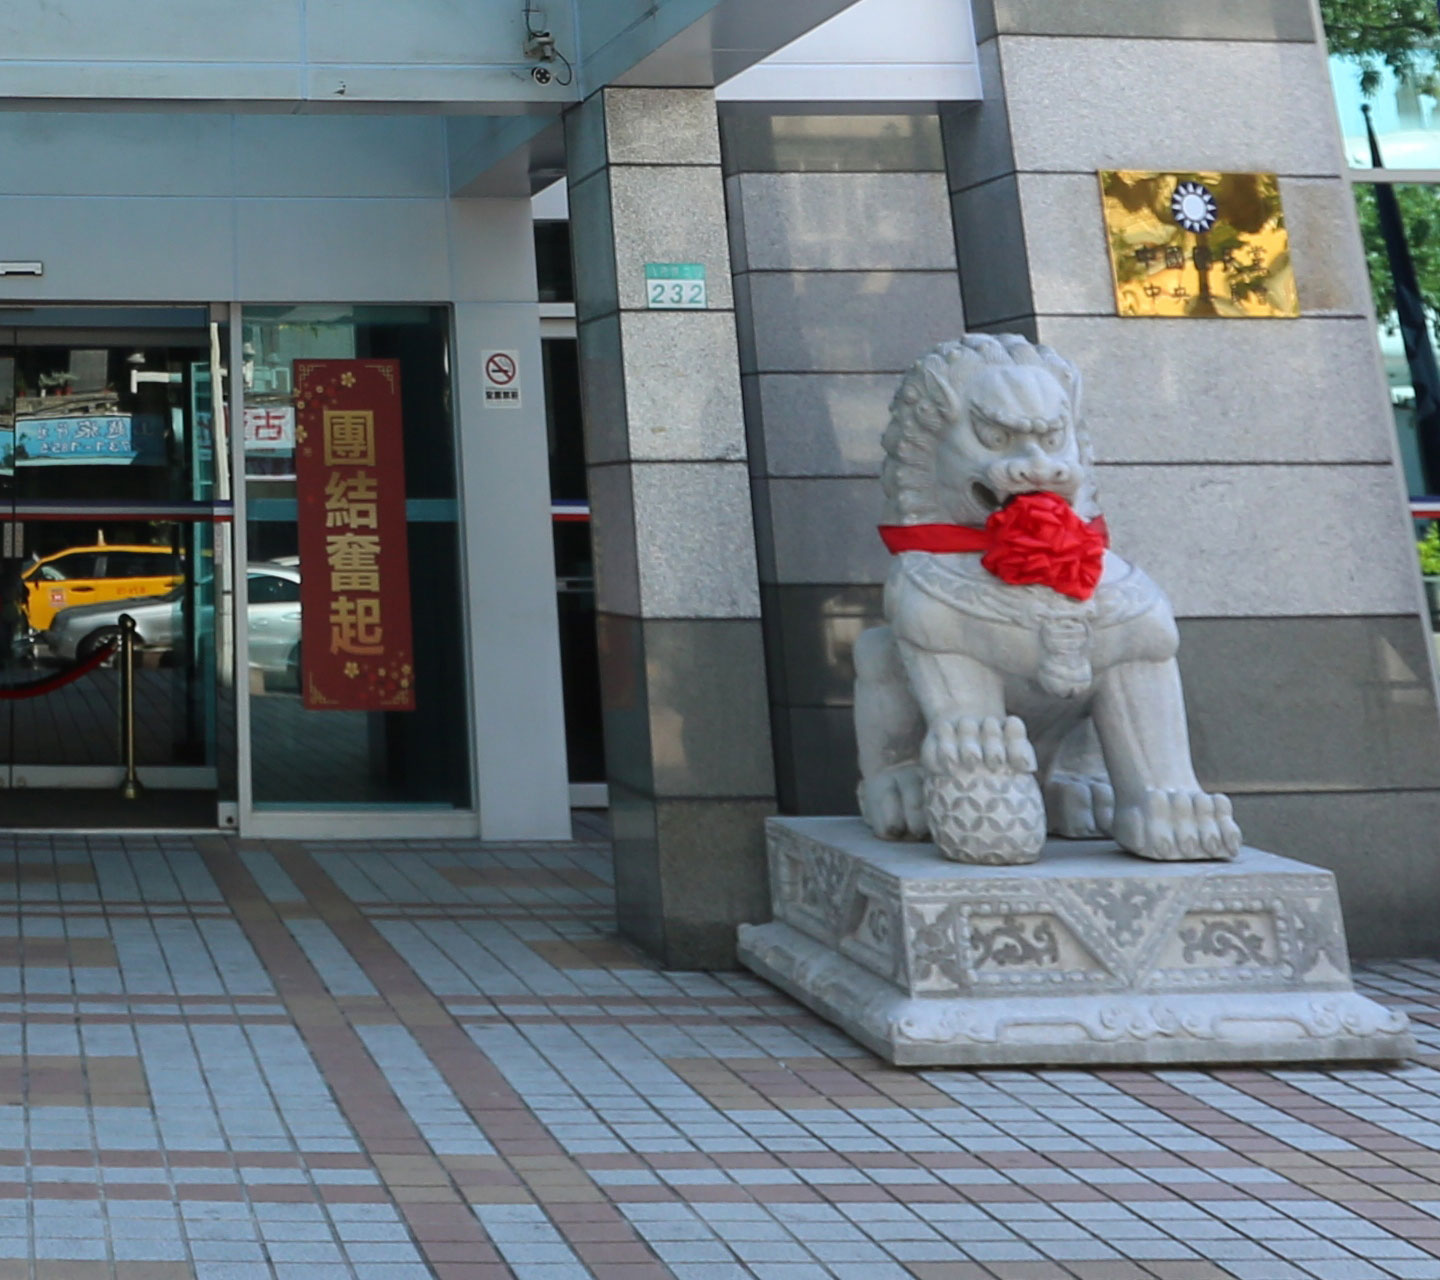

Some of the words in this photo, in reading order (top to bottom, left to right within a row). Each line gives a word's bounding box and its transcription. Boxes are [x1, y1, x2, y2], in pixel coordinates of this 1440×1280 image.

[650, 283, 703, 304] 232
[323, 409, 385, 656] 團結奮起
